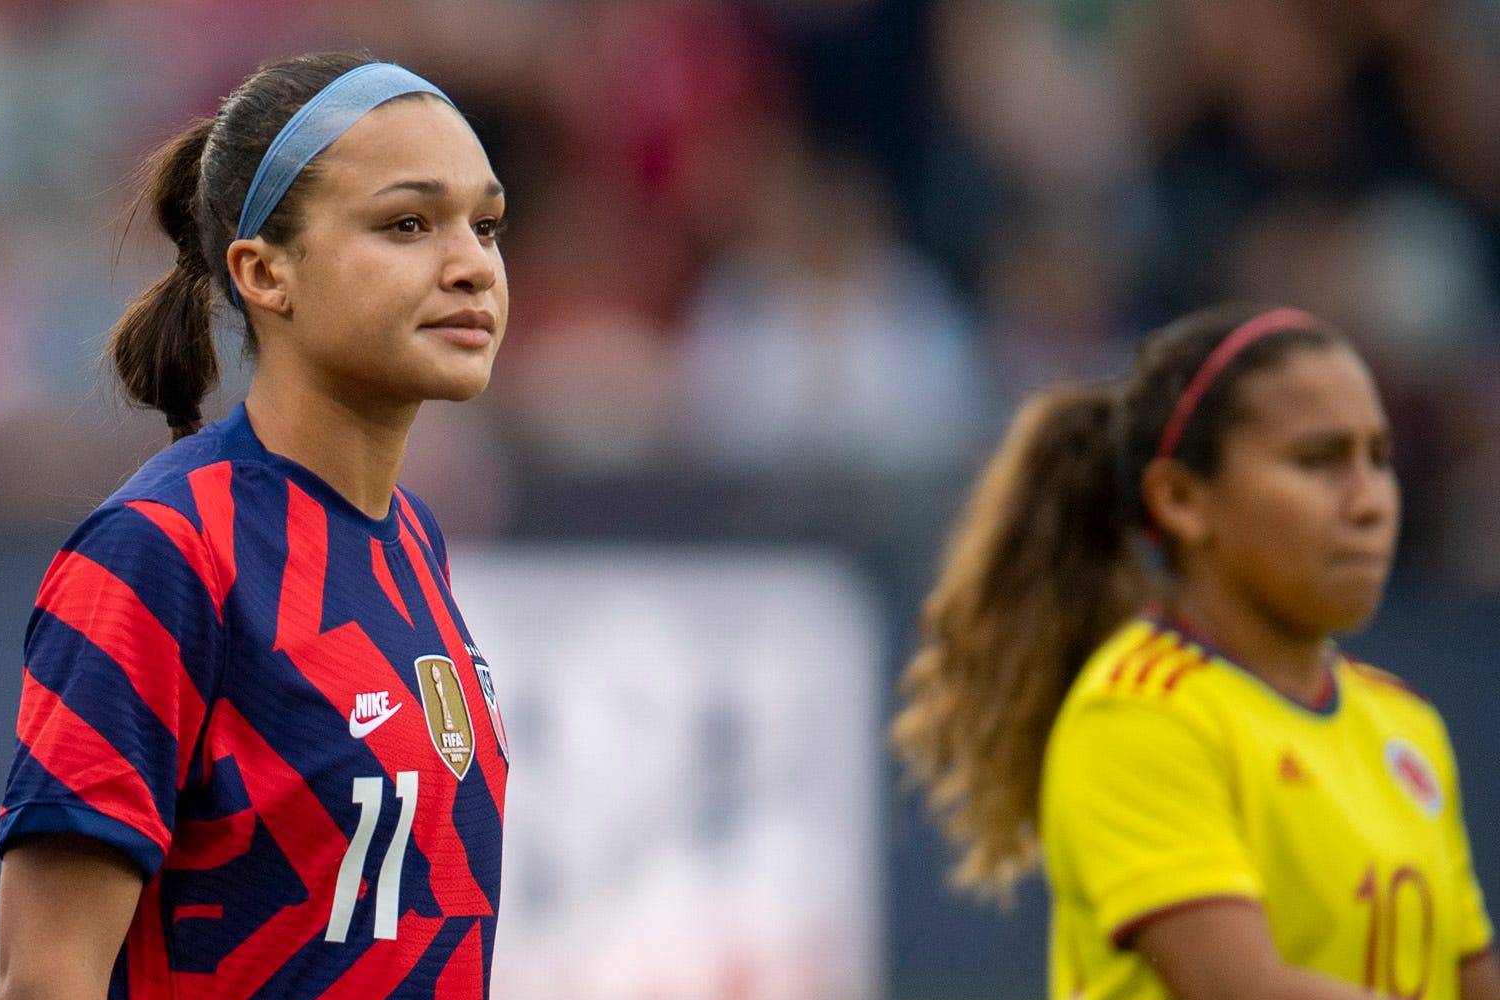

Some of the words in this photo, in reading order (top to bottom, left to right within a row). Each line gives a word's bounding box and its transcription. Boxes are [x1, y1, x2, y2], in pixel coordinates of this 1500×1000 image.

[355, 691, 390, 719] NIKE
[441, 732, 464, 748] FIFA
[324, 771, 419, 943] 11
